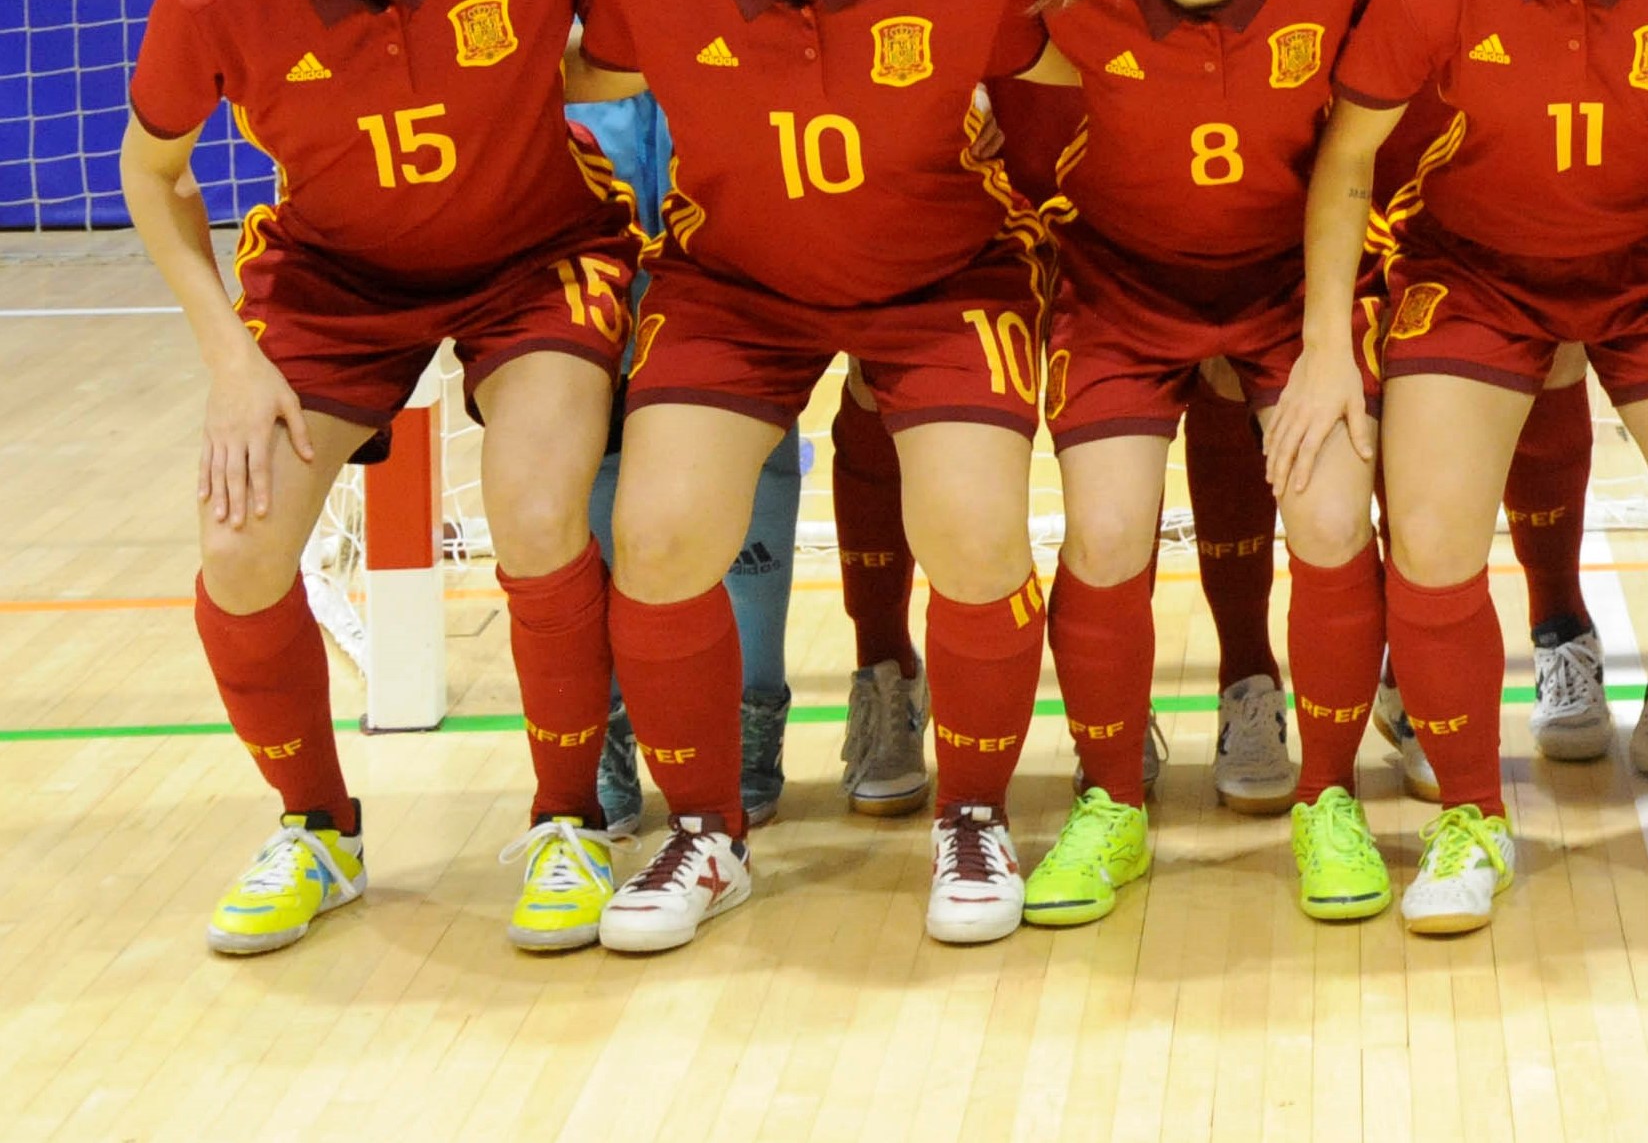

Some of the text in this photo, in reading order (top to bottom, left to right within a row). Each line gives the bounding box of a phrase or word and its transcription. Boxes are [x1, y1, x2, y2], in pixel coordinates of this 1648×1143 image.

[696, 54, 739, 67] adidas
[1469, 50, 1510, 65] adidas
[286, 69, 332, 82] adidas
[1105, 64, 1145, 80] adidas
[357, 104, 456, 188] 15
[1548, 102, 1603, 172] 11
[770, 111, 865, 199] 10
[1190, 123, 1243, 186] 8
[551, 256, 626, 343] 15
[963, 309, 1033, 404] 10
[1200, 535, 1265, 560] RFEF
[1300, 696, 1369, 724] RFEF
[938, 724, 1018, 752] RFEF
